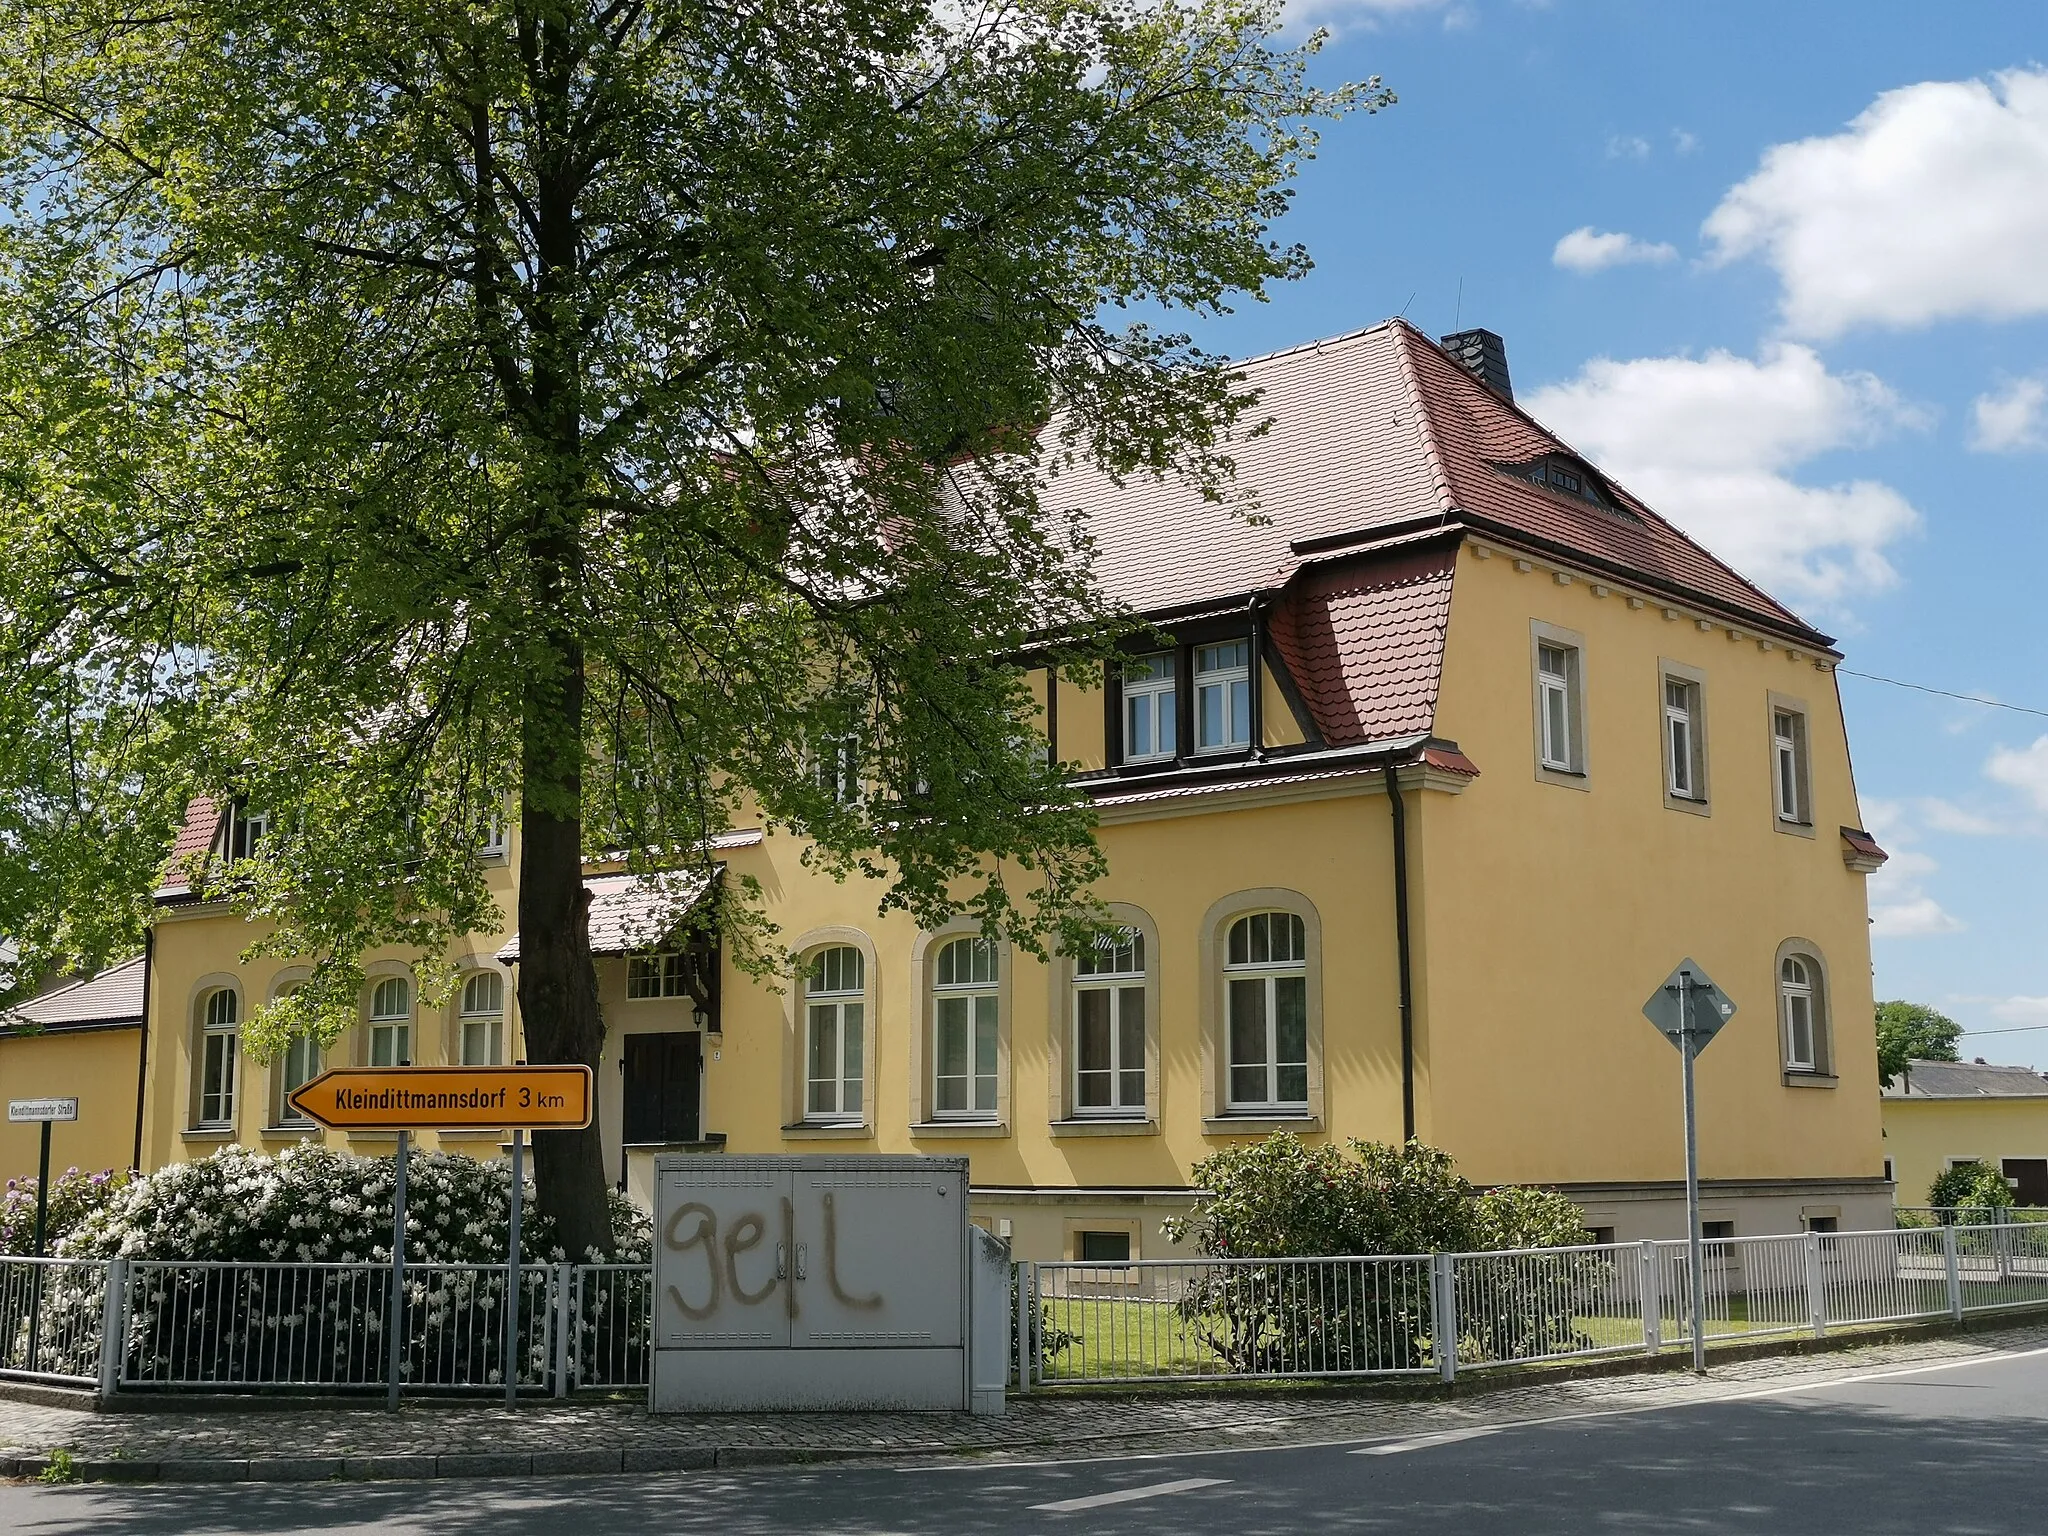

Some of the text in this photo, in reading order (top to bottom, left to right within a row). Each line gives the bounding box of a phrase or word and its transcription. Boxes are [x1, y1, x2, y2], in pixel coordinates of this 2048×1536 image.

[336, 1087, 564, 1109] Kleindittmannsdorf 3 km
[58, 1104, 73, 1115] Straße
